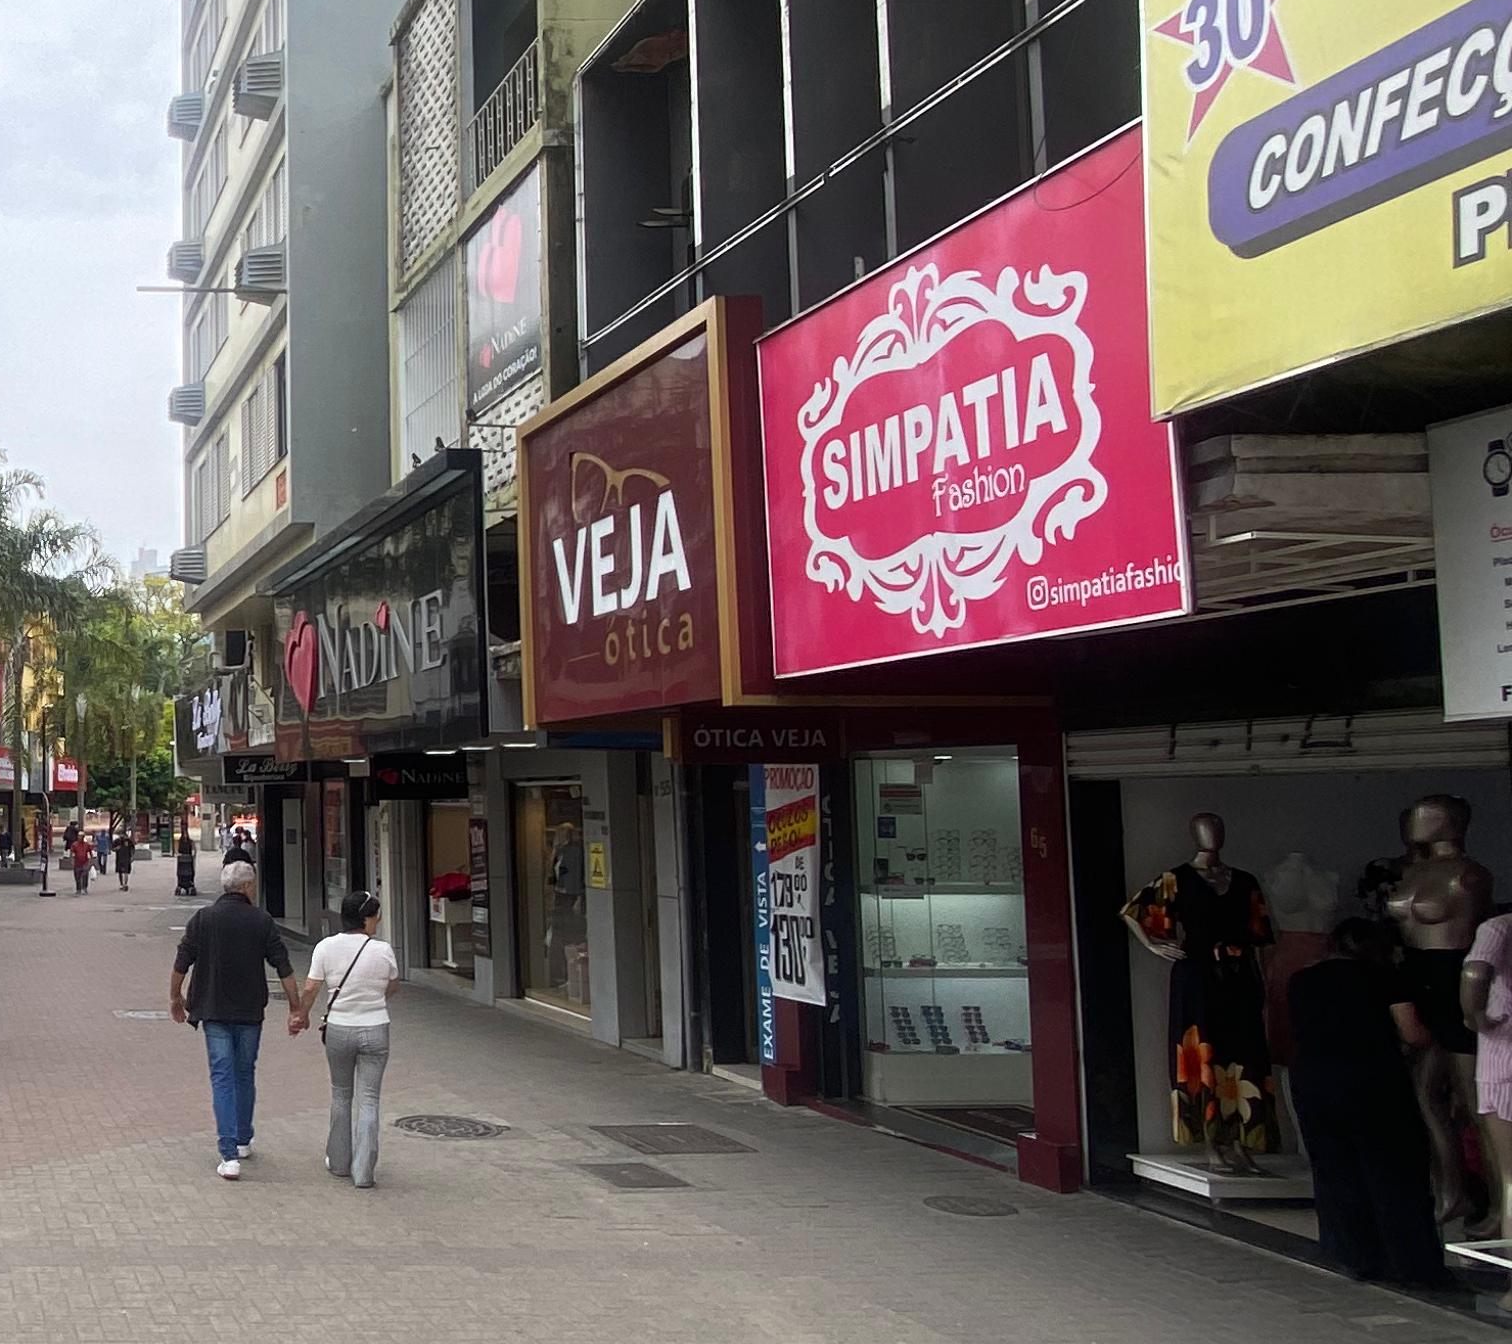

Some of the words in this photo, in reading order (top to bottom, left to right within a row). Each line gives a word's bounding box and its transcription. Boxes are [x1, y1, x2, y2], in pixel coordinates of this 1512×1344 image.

[822, 352, 1069, 511] SIMPATIA
[931, 462, 1026, 518] Fashion
[552, 489, 692, 625] VEJA
[604, 609, 694, 666] ótica
[693, 723, 765, 749] ÓTICA
[771, 728, 827, 747] VEJA
[755, 870, 769, 928] VISTA
[759, 943, 770, 971] DE
[760, 985, 775, 1060] EXAME
